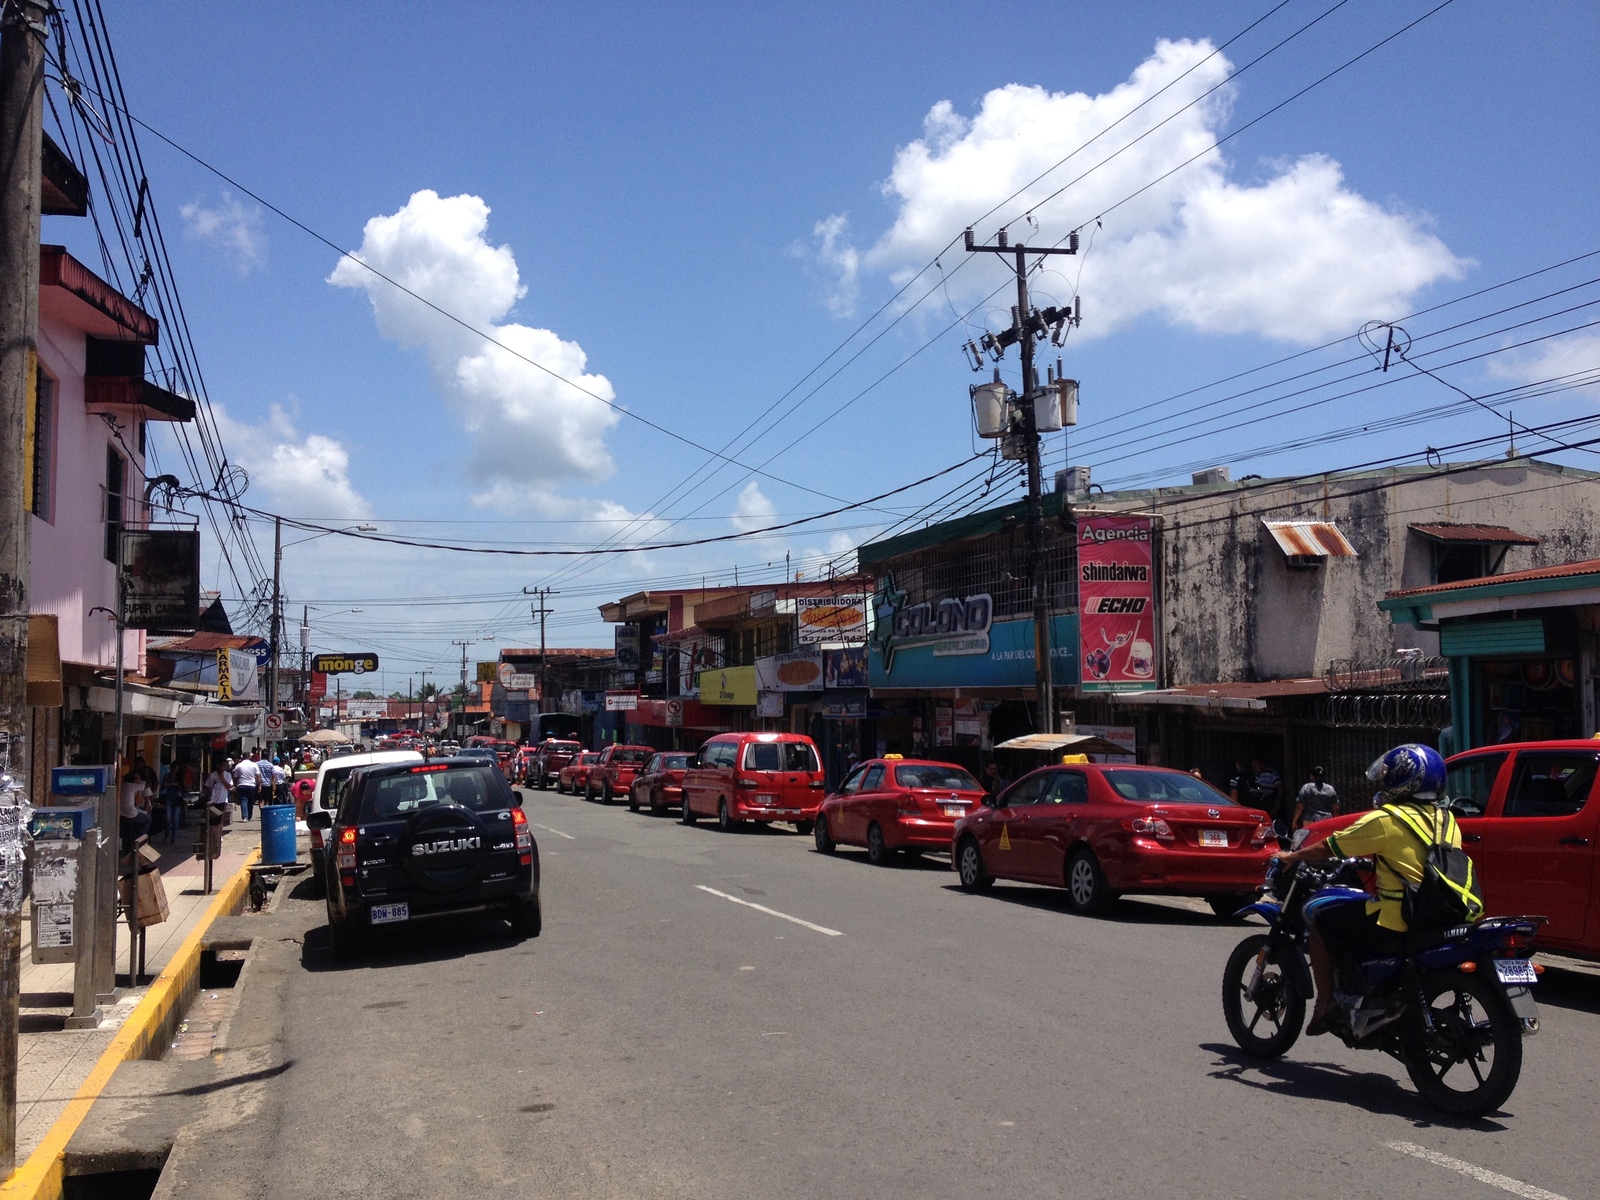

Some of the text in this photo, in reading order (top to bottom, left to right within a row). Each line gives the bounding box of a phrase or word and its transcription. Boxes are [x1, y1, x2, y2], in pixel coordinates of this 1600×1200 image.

[1082, 525, 1148, 544] Agencia
[1082, 561, 1147, 581] shindaiwa
[124, 603, 152, 613] SUPER
[799, 598, 863, 606] DISTRIBUIDORA
[1097, 597, 1147, 613] ECHO
[894, 597, 989, 637] COLONO
[774, 651, 821, 661] DISTRIBUIDORA
[1004, 650, 1016, 660] PAR
[218, 647, 231, 700] FARMACIA
[319, 659, 374, 673] monge
[411, 837, 481, 856] SUZUKI
[1443, 928, 1468, 938] YAMAHA
